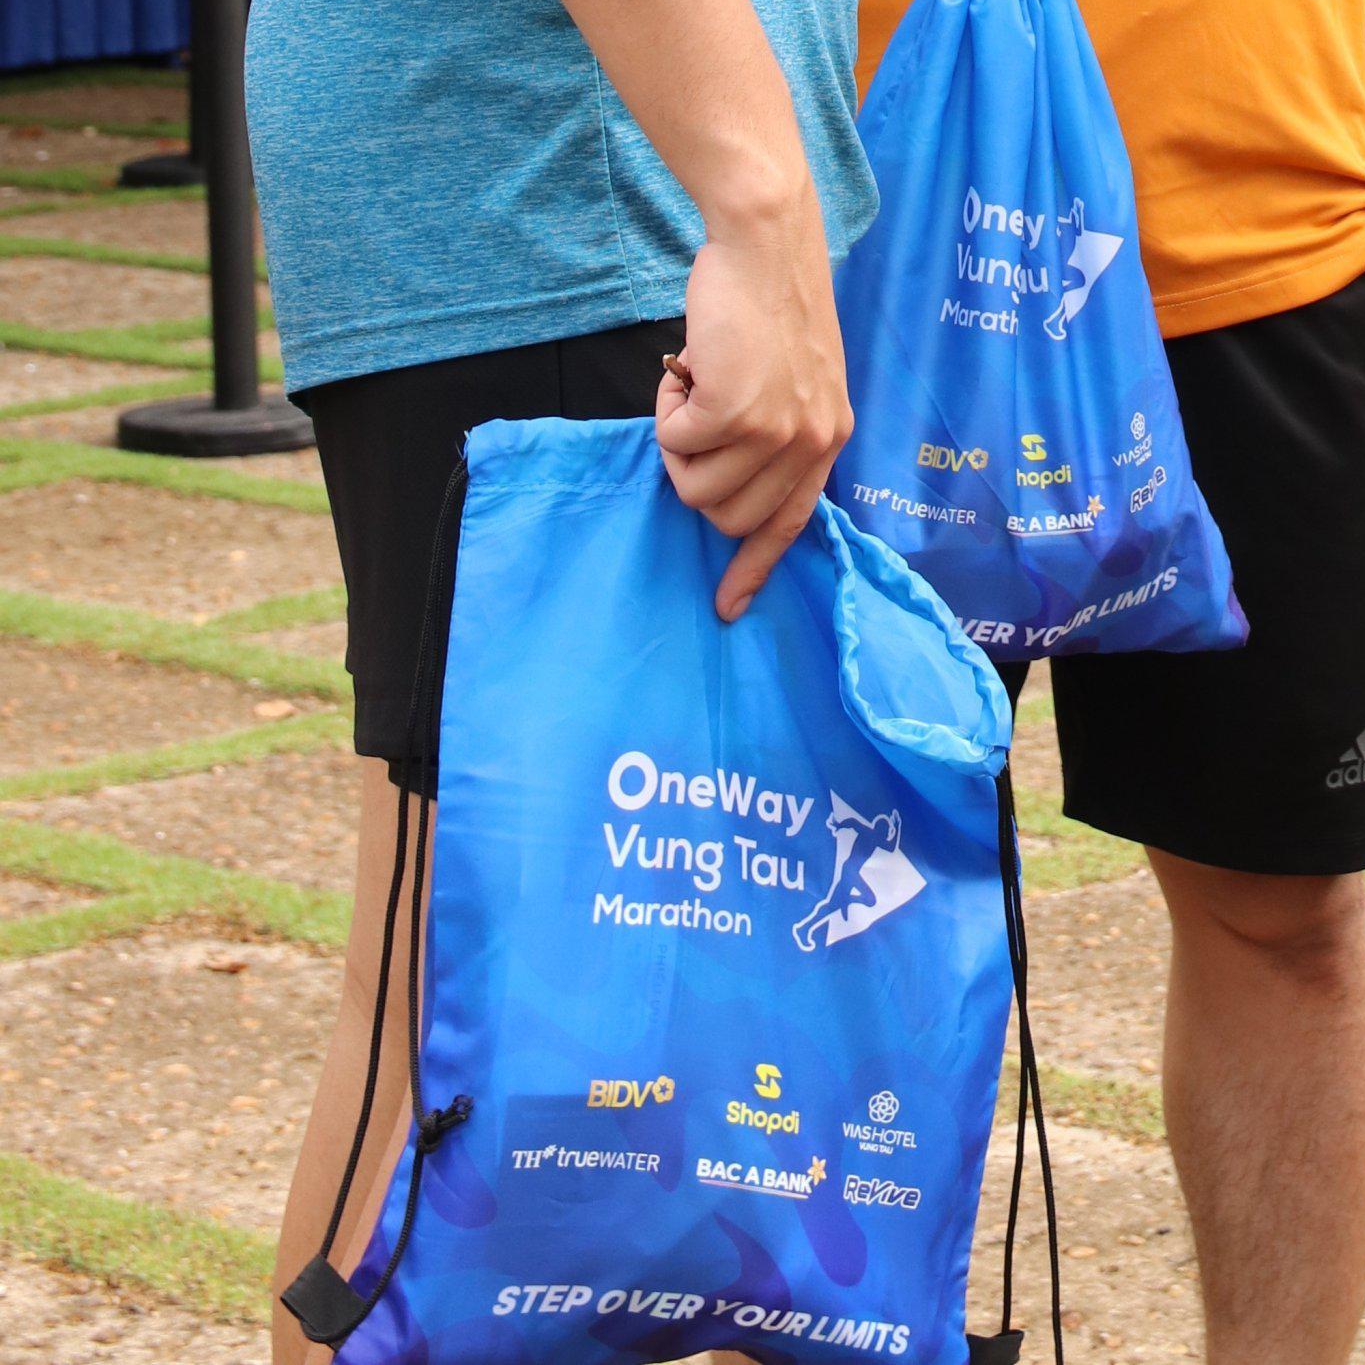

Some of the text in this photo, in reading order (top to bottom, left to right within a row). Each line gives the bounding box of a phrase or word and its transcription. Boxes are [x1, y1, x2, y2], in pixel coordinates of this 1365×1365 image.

[917, 442, 968, 472] BIDV
[1015, 464, 1072, 489] hopdi
[853, 483, 878, 506] TH
[1045, 511, 1095, 531] BANK
[955, 566, 1179, 648] VER YOUR LIMITS
[607, 750, 815, 837] OneWay
[603, 822, 805, 892] Vung Tau
[593, 893, 752, 937] Marathon
[587, 1079, 655, 1108] BIDV
[726, 1100, 800, 1135] Shopdi
[512, 1150, 545, 1170] TH
[696, 1158, 813, 1194] BAC A BANK
[492, 1284, 911, 1355] STEP OVER YOUR LIMITS
